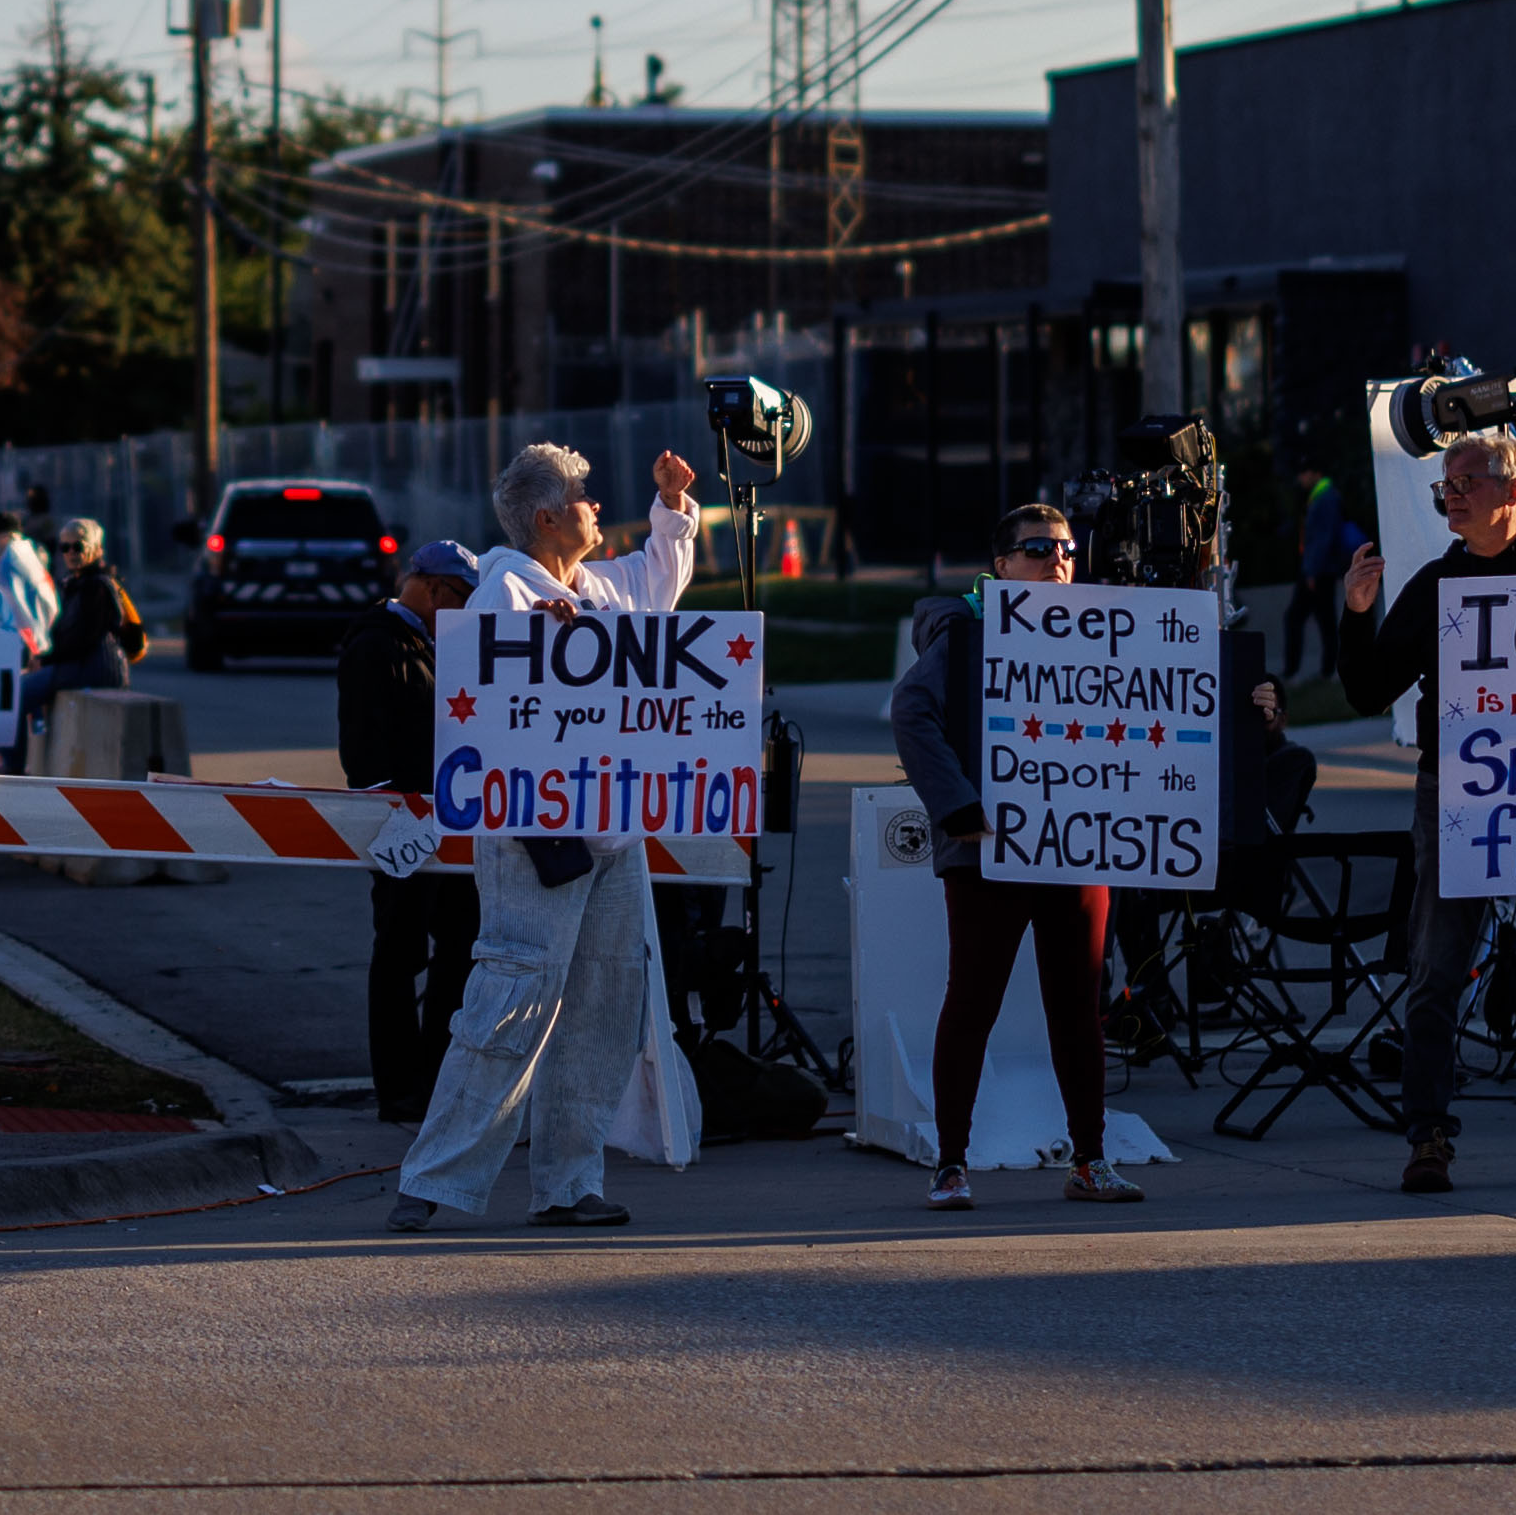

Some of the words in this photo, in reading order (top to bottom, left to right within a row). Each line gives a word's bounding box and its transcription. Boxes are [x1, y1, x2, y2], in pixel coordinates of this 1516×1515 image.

[478, 613, 728, 690] HONK
[999, 588, 1136, 658] Keep
[1156, 608, 1200, 644] the
[984, 657, 1217, 717] IMMIGRANTS
[1476, 686, 1504, 714] is
[509, 695, 541, 730] if
[554, 707, 606, 743] you
[619, 695, 695, 735] LOVE
[701, 700, 746, 730] the
[434, 745, 758, 837] Constitution
[990, 744, 1141, 802] Deport
[1158, 764, 1197, 792] the
[375, 833, 437, 873] YOU
[994, 802, 1203, 878] RACISTS
